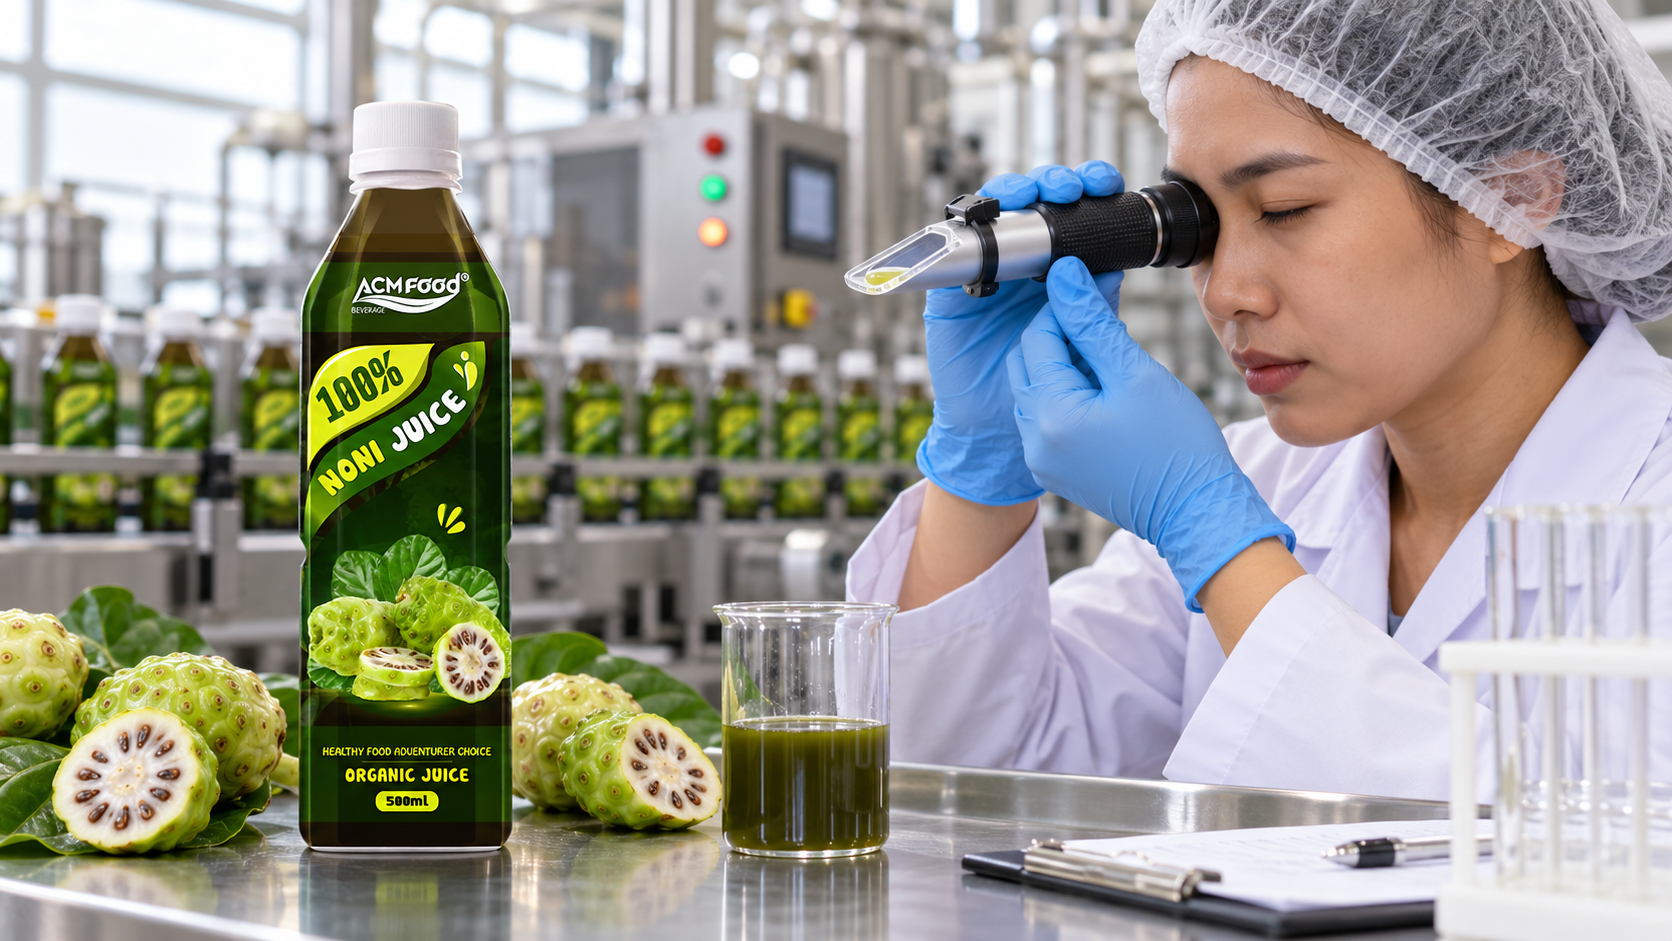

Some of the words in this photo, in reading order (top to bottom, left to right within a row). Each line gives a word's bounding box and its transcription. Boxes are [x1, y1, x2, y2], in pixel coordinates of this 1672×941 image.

[351, 306, 386, 314] BEVERAGE
[315, 350, 404, 423] 100%
[317, 439, 386, 496] NONI
[391, 388, 467, 452] JUICE
[322, 746, 364, 756] HEALTHY
[366, 746, 392, 756] FOOD
[457, 746, 492, 756] CHOICE
[345, 767, 415, 782] ORGANIC
[421, 767, 469, 782] JUICE
[386, 795, 429, 806] 500ml
